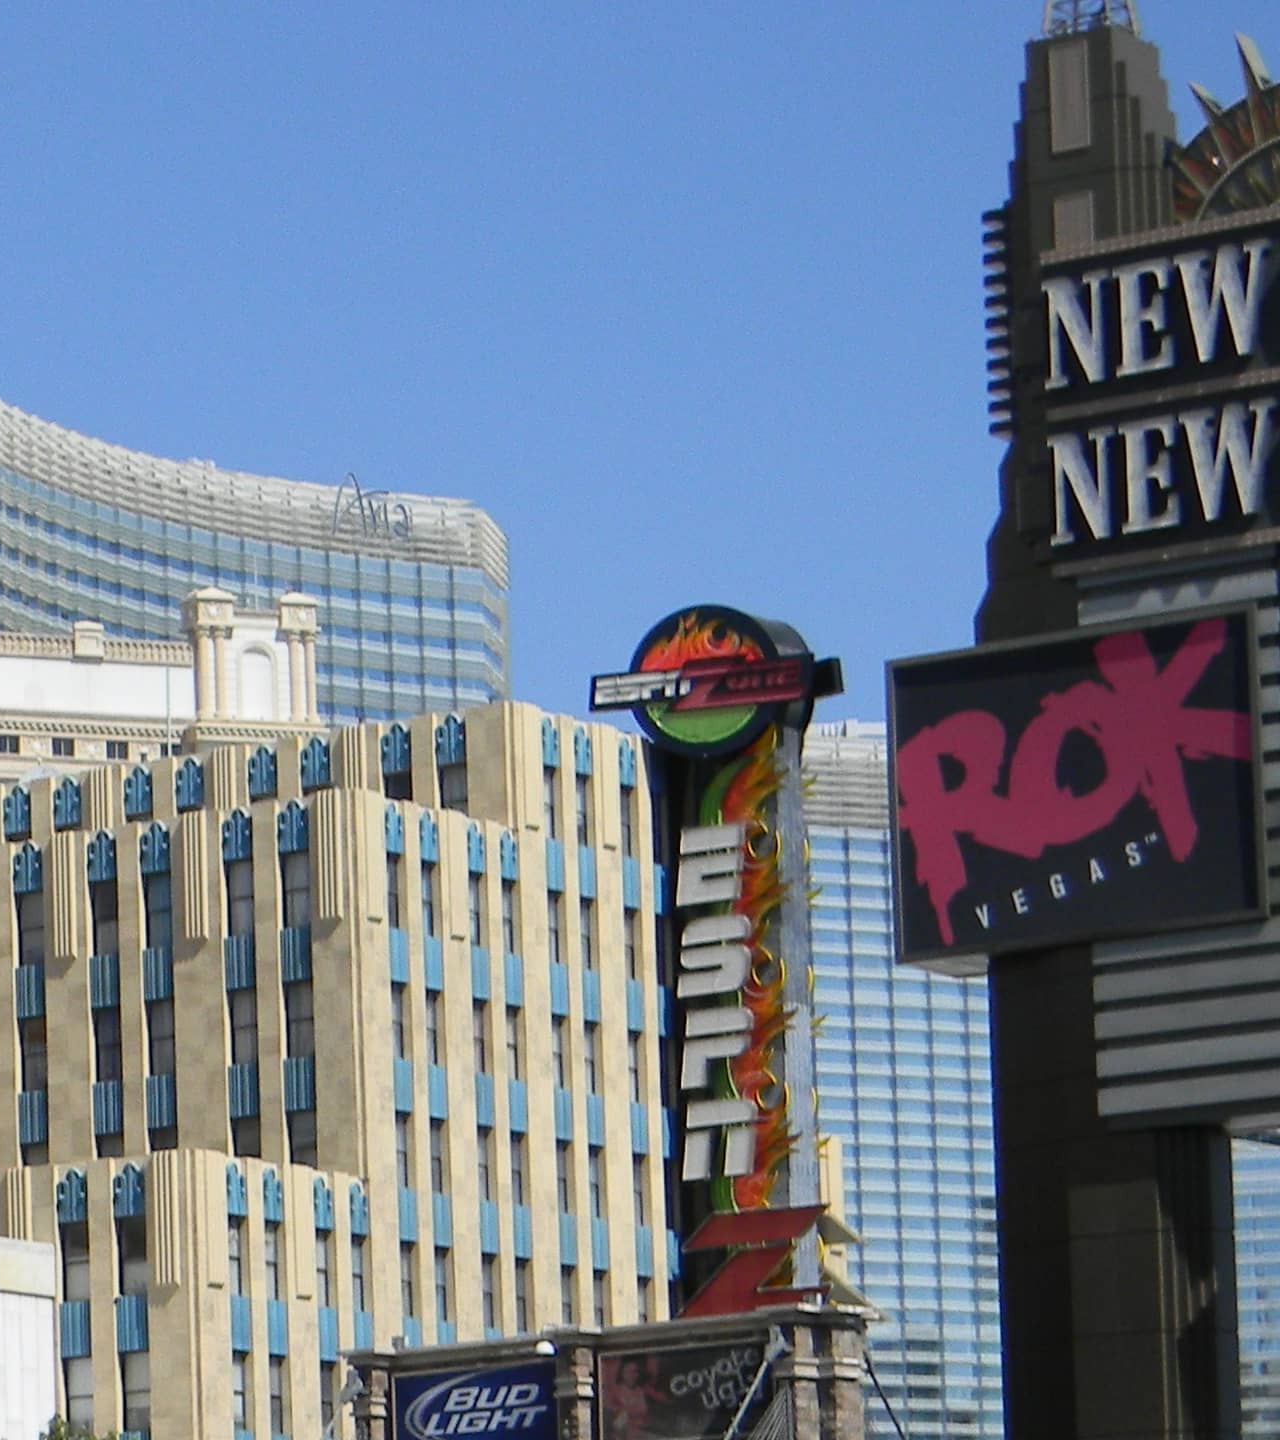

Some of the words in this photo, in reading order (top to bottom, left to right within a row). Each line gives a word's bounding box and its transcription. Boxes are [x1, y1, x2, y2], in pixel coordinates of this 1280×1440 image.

[1042, 238, 1271, 390] NEW
[1046, 398, 1277, 546] NEW
[896, 617, 1255, 946] ROK
[976, 841, 1143, 930] VEGAS
[676, 824, 760, 1181] ESPN
[423, 1404, 549, 1438] LIGHT
[443, 1383, 540, 1414] BUD
